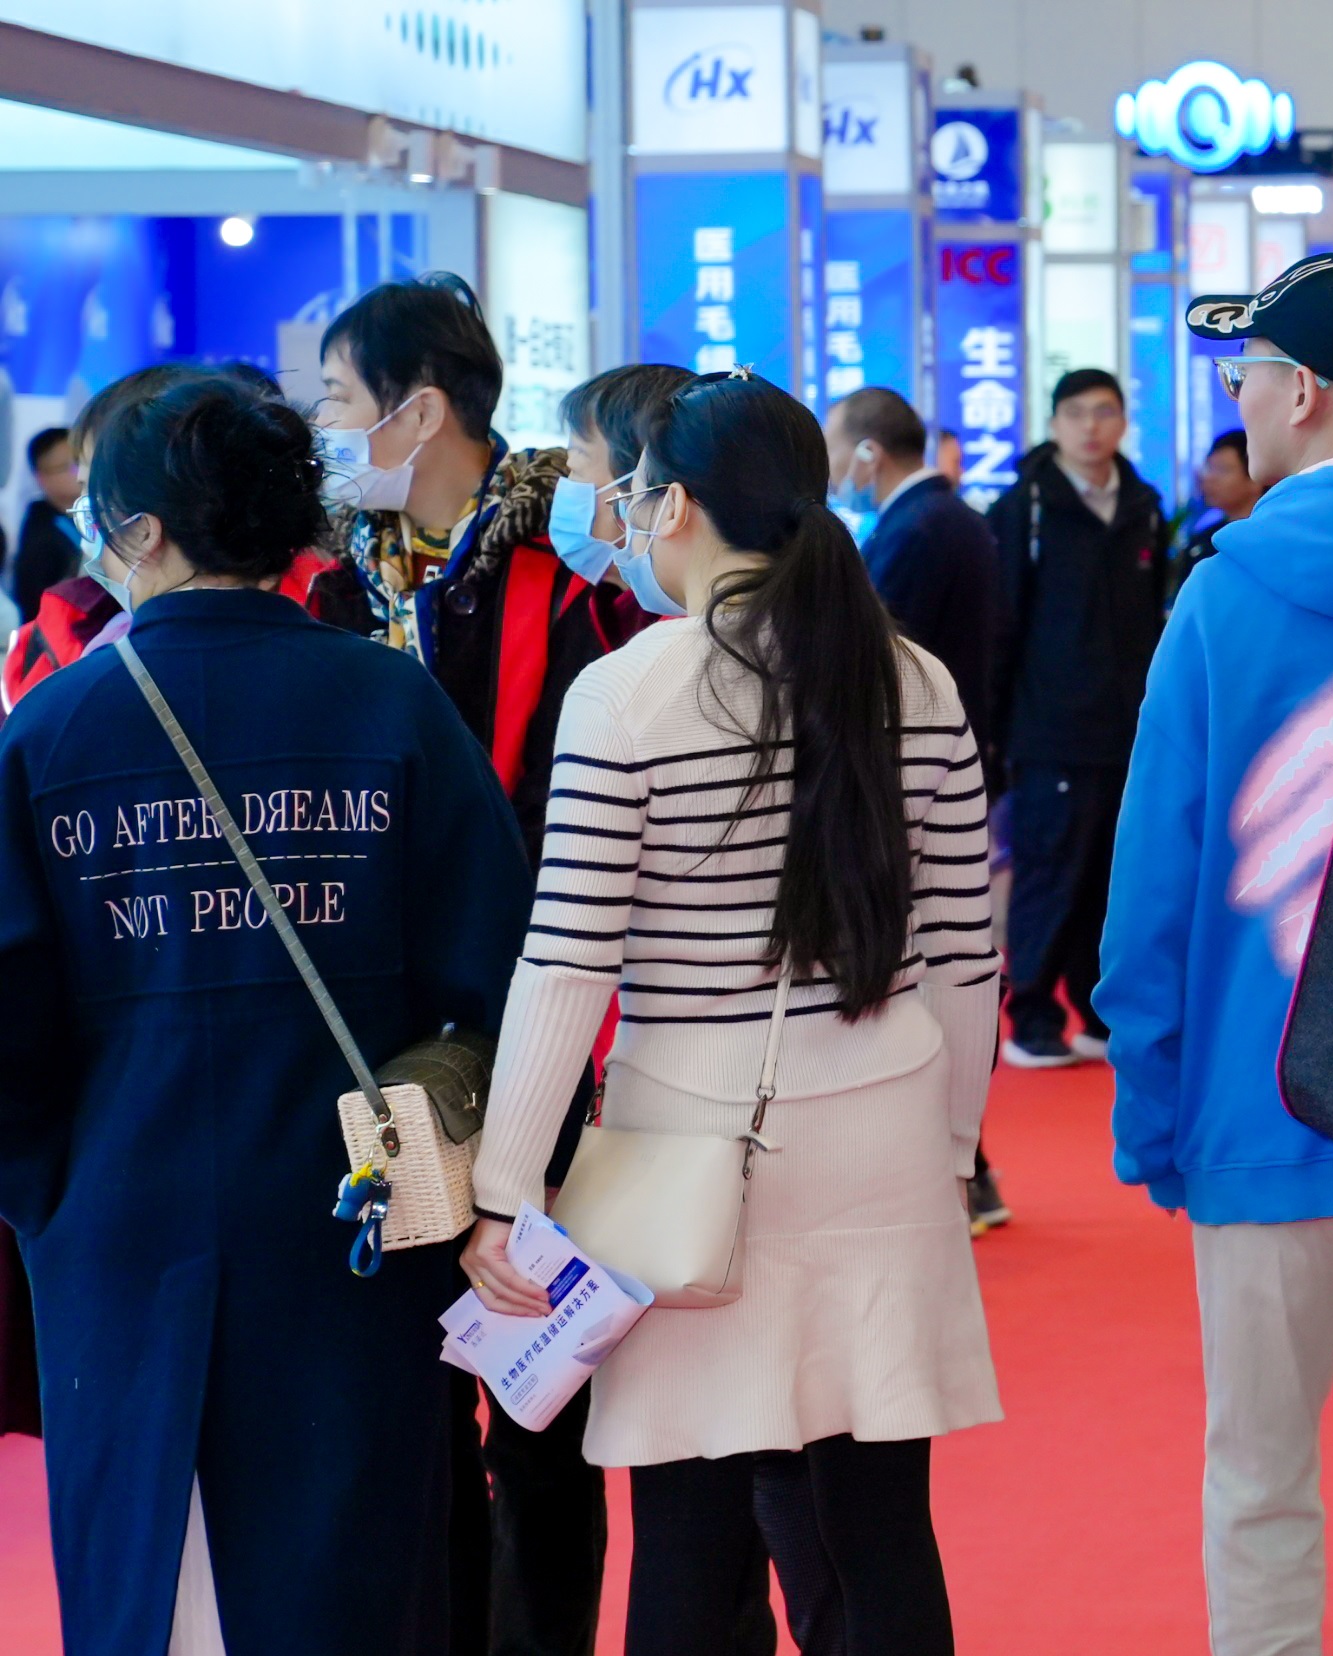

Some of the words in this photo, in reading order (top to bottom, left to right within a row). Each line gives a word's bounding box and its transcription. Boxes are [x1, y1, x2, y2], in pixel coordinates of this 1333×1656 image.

[942, 248, 1012, 285] ICC
[51, 810, 95, 858] GO
[112, 797, 223, 848] AFTER
[190, 882, 346, 933] PEOPLE
[500, 1278, 601, 1391] 生物医疗低温储运解决方案
